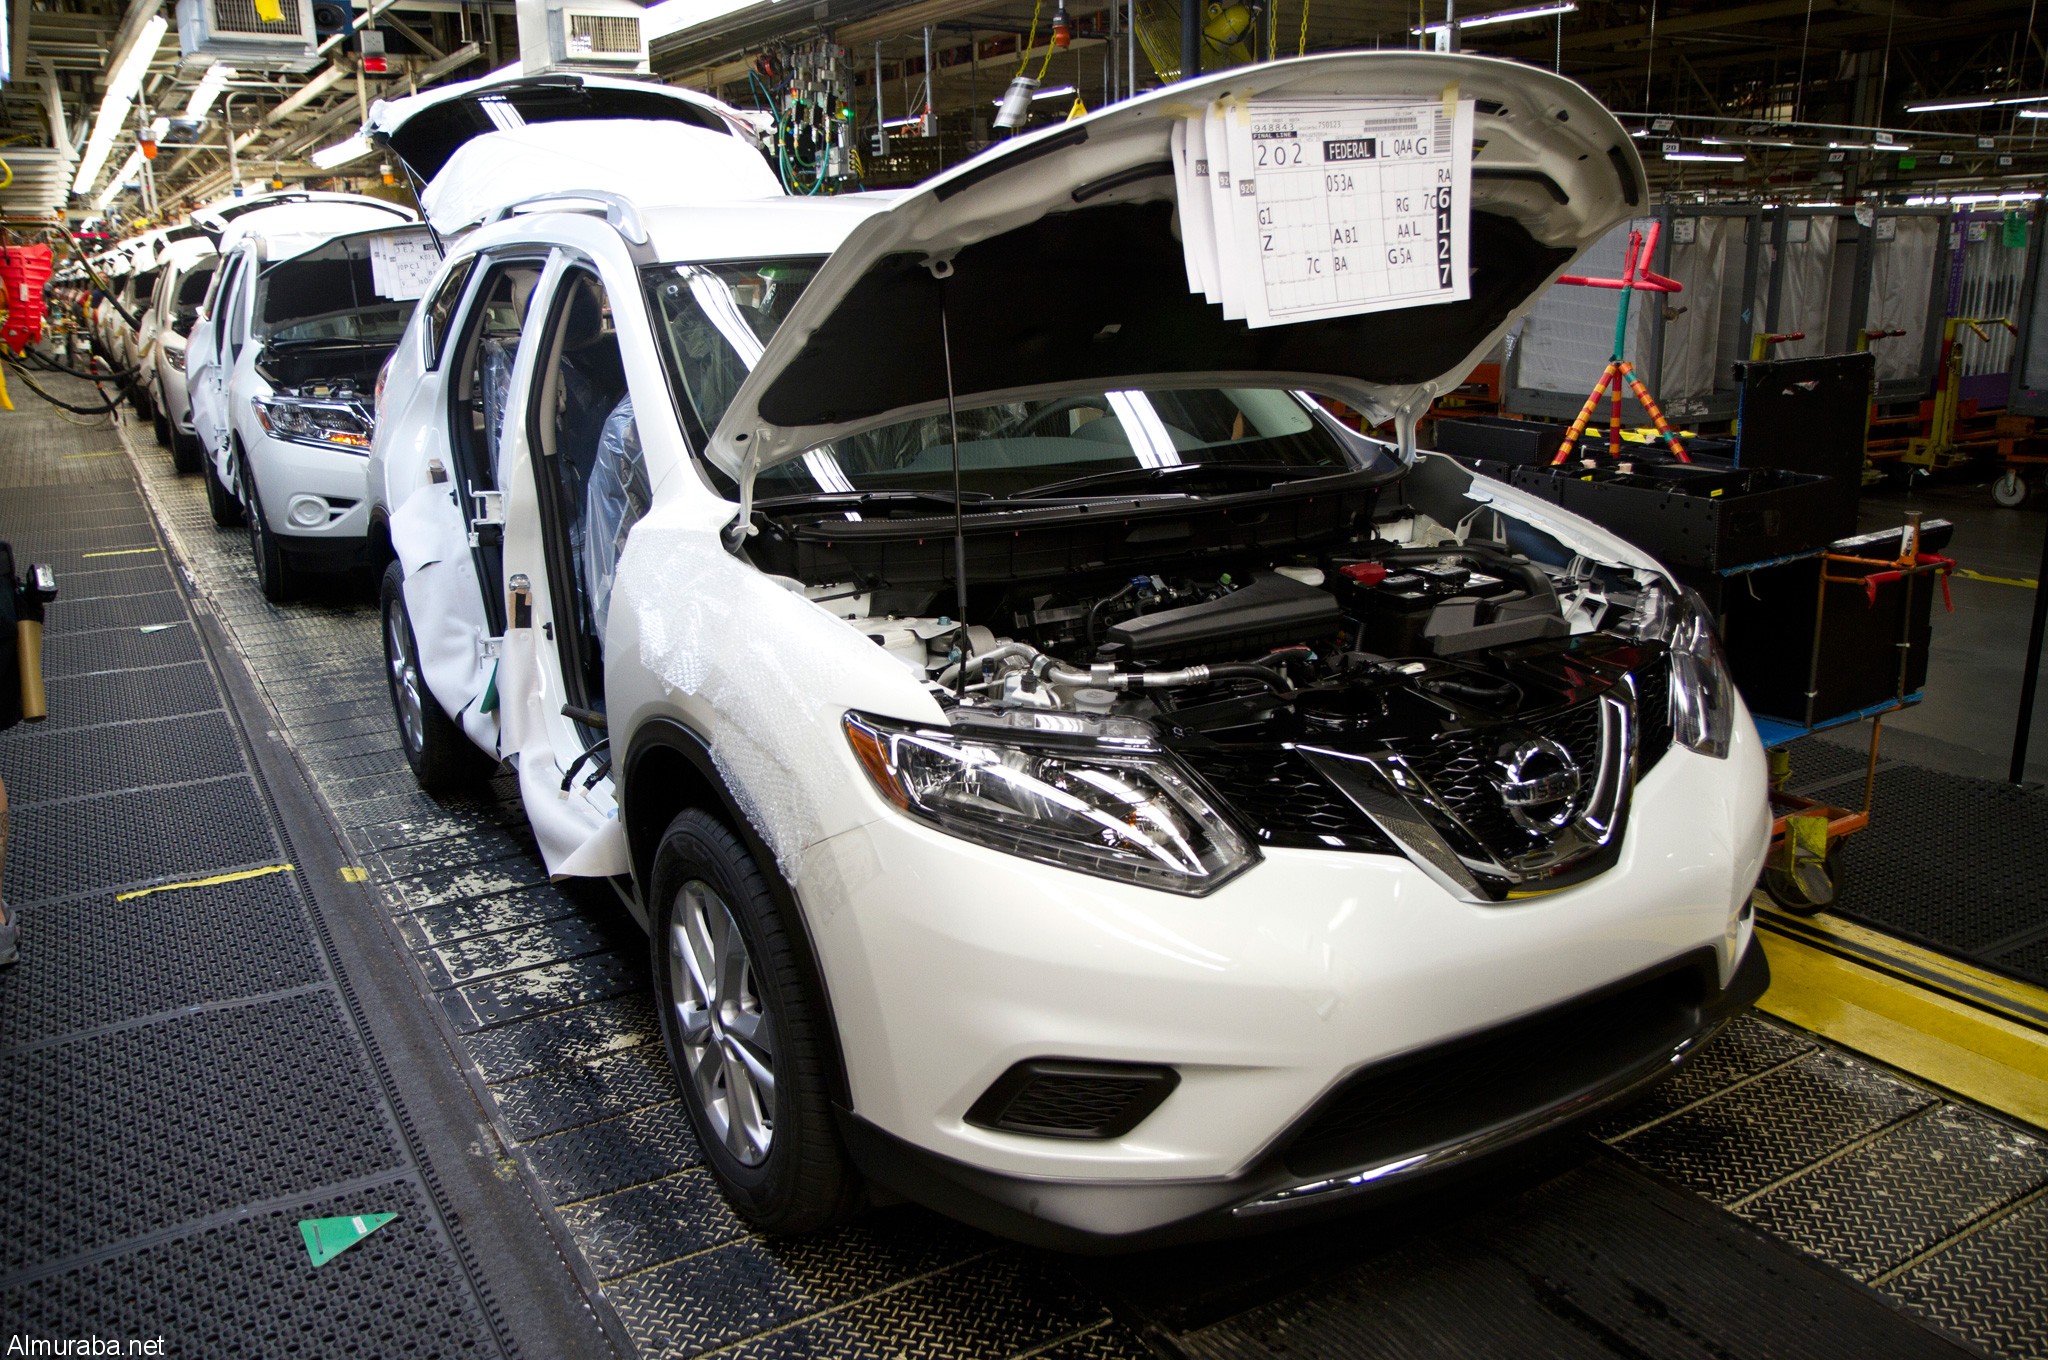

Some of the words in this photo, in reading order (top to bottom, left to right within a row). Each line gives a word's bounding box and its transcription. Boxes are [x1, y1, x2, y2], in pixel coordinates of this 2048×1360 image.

[1254, 123, 1295, 132] 948843
[1328, 141, 1371, 160] FEDERAL
[1326, 174, 1354, 192] 053A
[1438, 168, 1451, 183] RA
[1396, 197, 1409, 213] RG
[1258, 207, 1273, 225] G1
[1263, 234, 1274, 251] Z
[1437, 187, 1451, 285] 6127
[1307, 257, 1321, 275] 7C
[1334, 256, 1348, 272] BA
